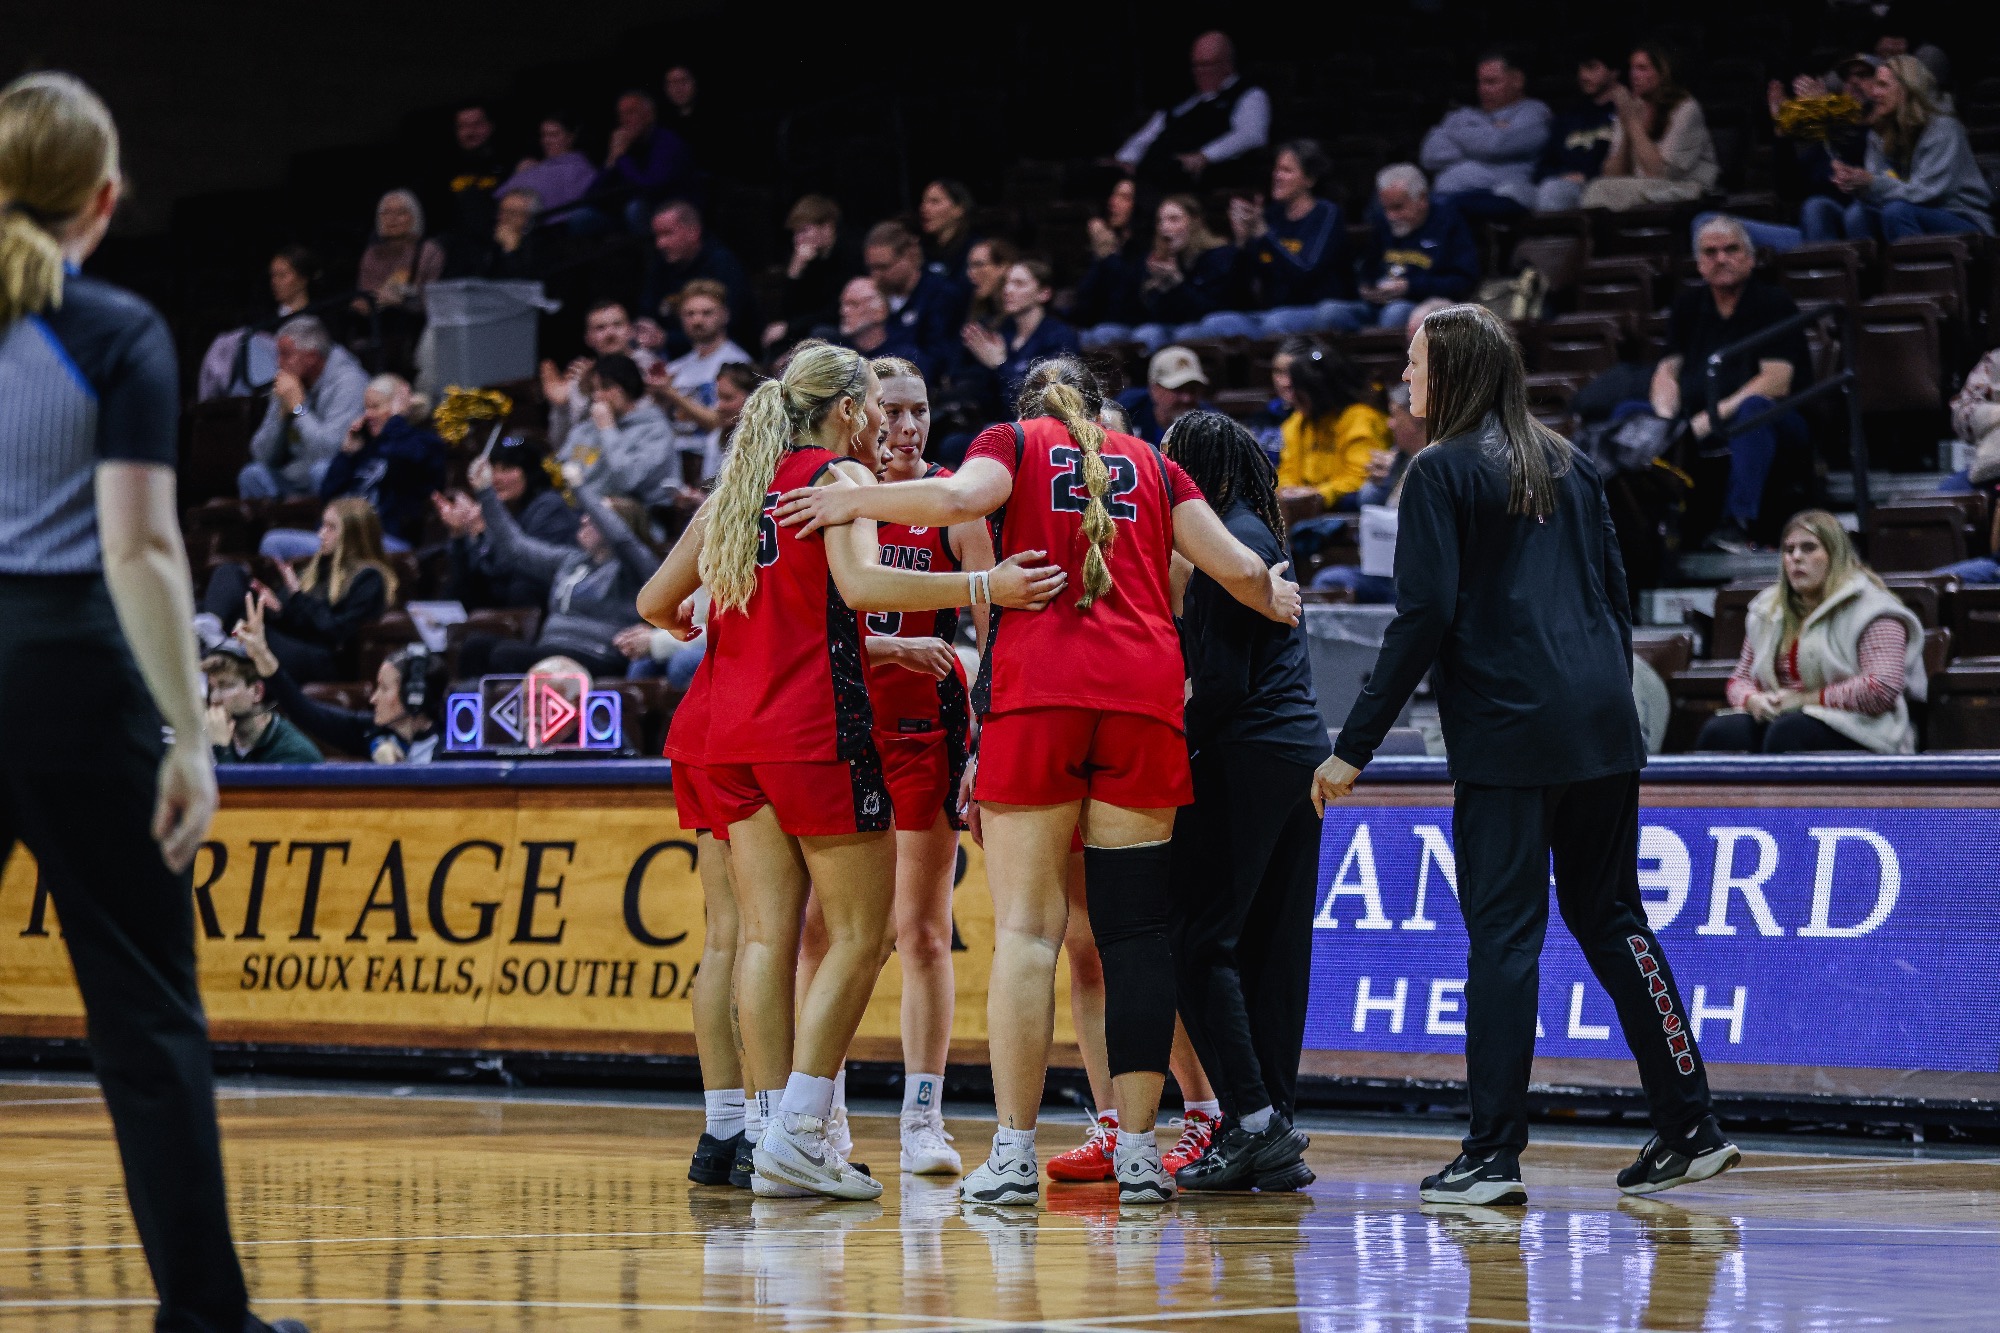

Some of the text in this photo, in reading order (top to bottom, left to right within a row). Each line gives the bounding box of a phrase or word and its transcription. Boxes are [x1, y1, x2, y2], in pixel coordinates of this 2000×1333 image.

[1049, 445, 1137, 522] 22
[878, 544, 933, 572] ONS
[19, 840, 576, 947] RITAGE
[240, 953, 353, 992] SIOUX
[363, 955, 482, 1002] FALLS,
[498, 956, 638, 998] SOUTH
[1351, 975, 1747, 1045] HELH
